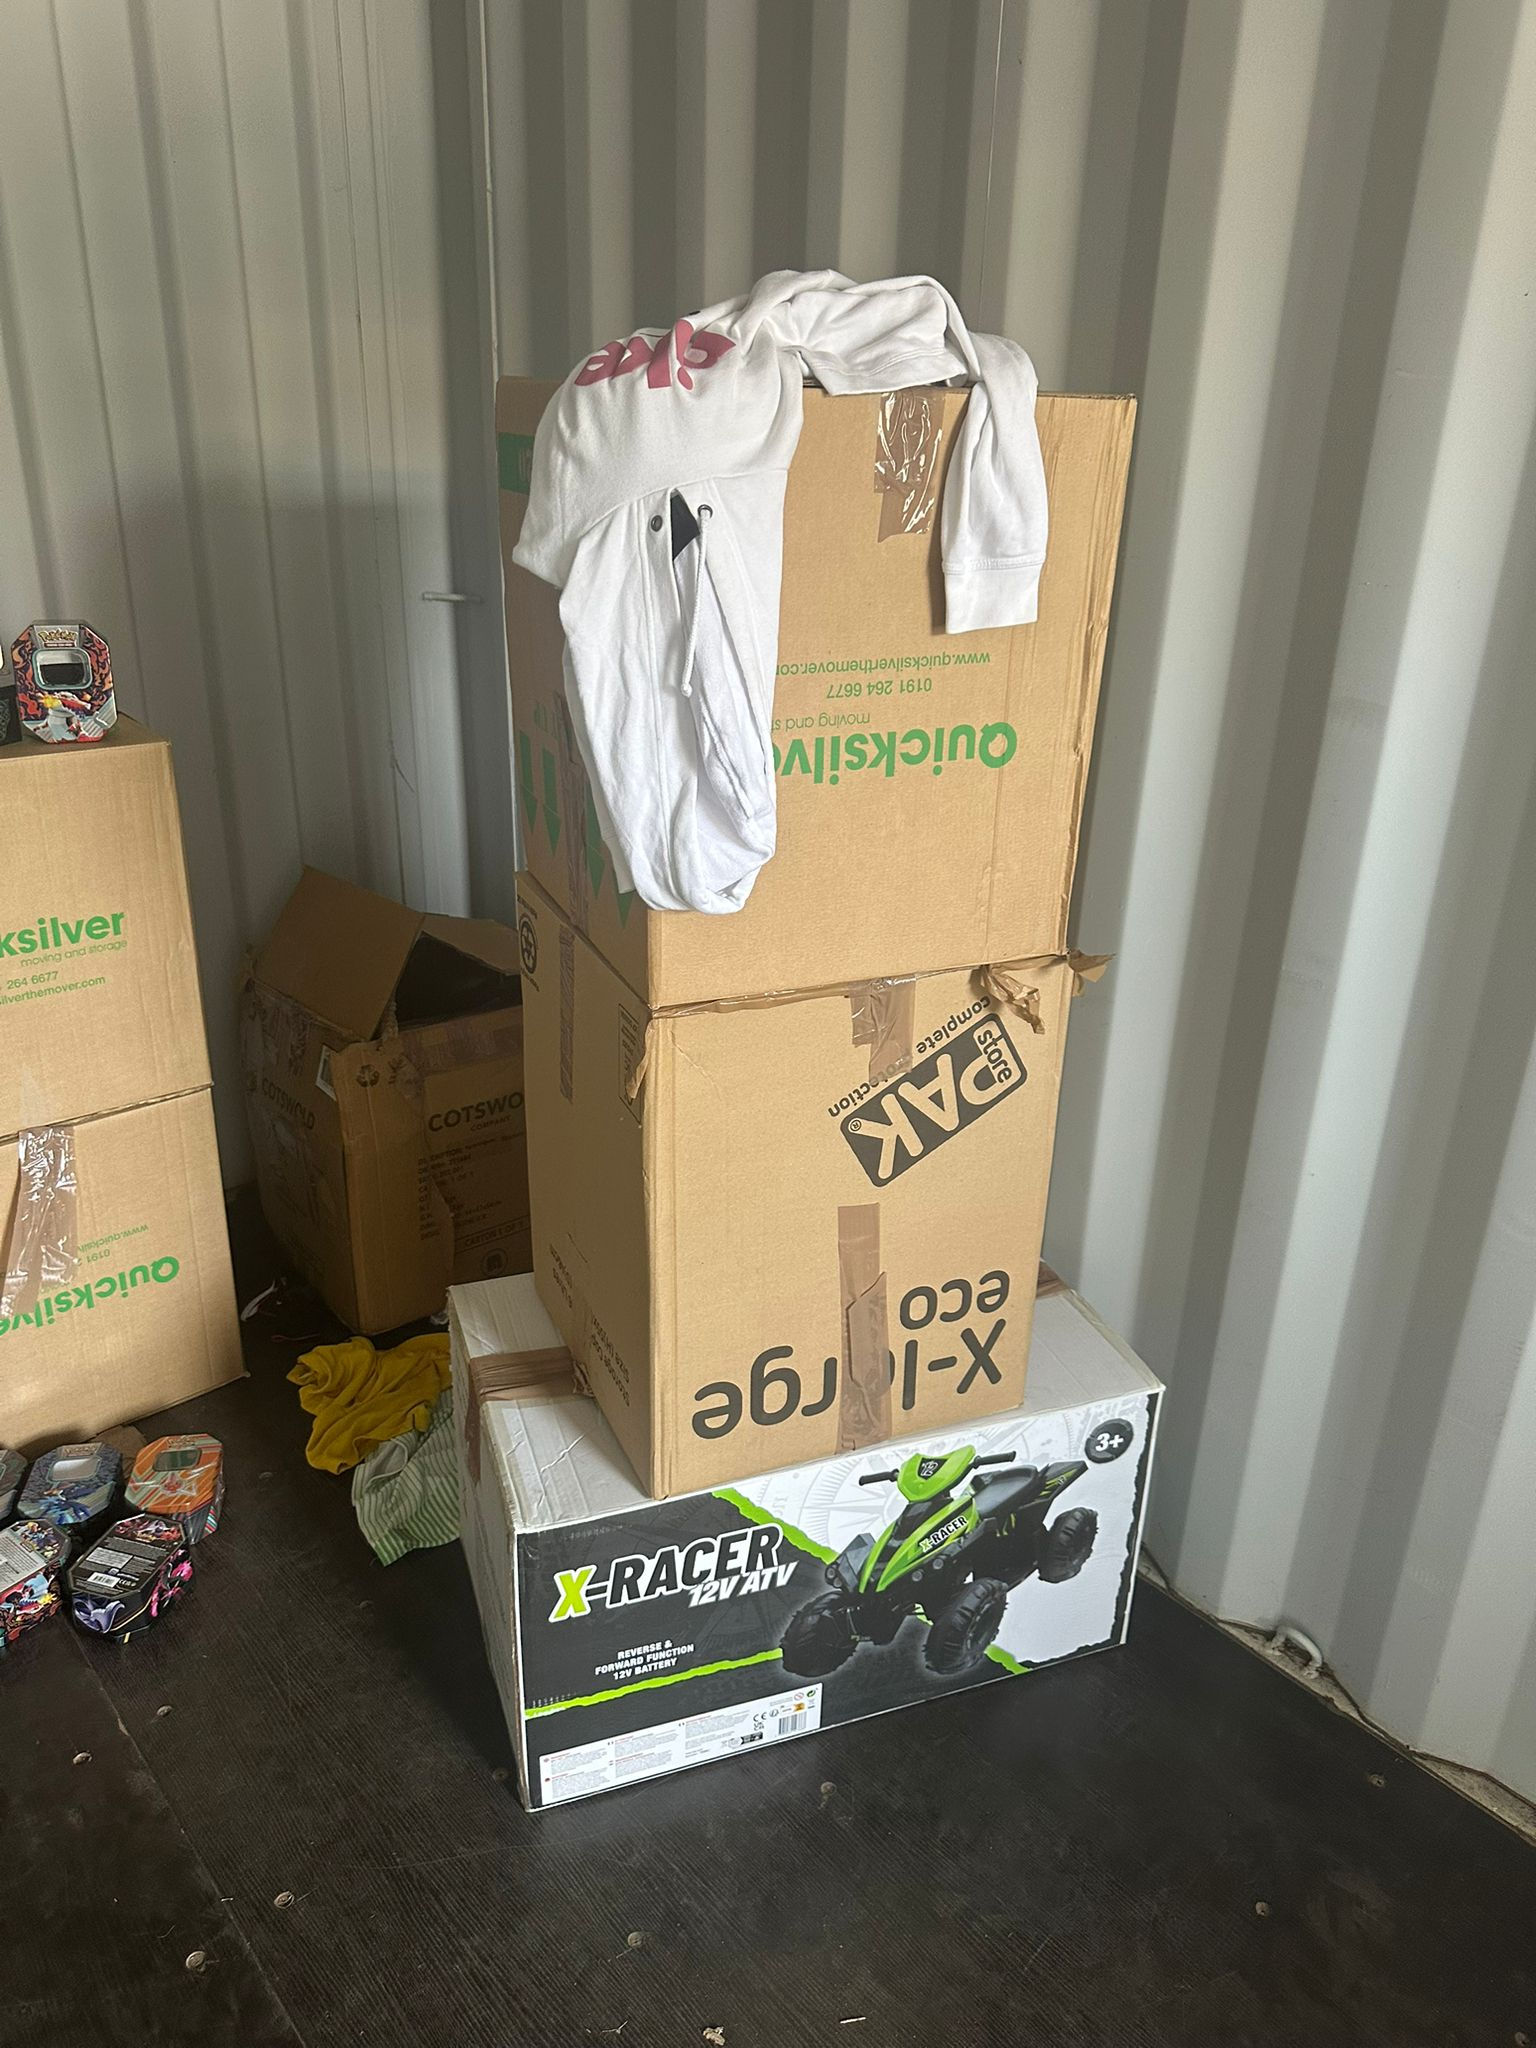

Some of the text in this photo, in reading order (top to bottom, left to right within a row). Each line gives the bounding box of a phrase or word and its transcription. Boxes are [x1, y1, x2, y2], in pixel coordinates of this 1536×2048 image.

[826, 677, 932, 699] 0191 264 6677
[785, 714, 815, 731] and
[818, 711, 871, 728] moving
[20, 939, 128, 968] moving and storage
[6, 970, 59, 990] 264 6677
[916, 996, 991, 1054] complete
[977, 1029, 1013, 1084] store
[847, 1020, 1023, 1179] PAK
[86, 1248, 110, 1263] 0191
[900, 1269, 1010, 1330] eco
[692, 1318, 1006, 1440] X-lrge
[1095, 1431, 1124, 1452] 3+
[919, 1515, 968, 1553] X-RACER
[549, 1523, 784, 1623] X-RACER
[688, 1560, 799, 1609] 12V ATV
[594, 1643, 694, 1676] FORWARD FUNCTION
[617, 1639, 673, 1660] REVERSE &
[613, 1657, 678, 1680] 12V BATTERY
